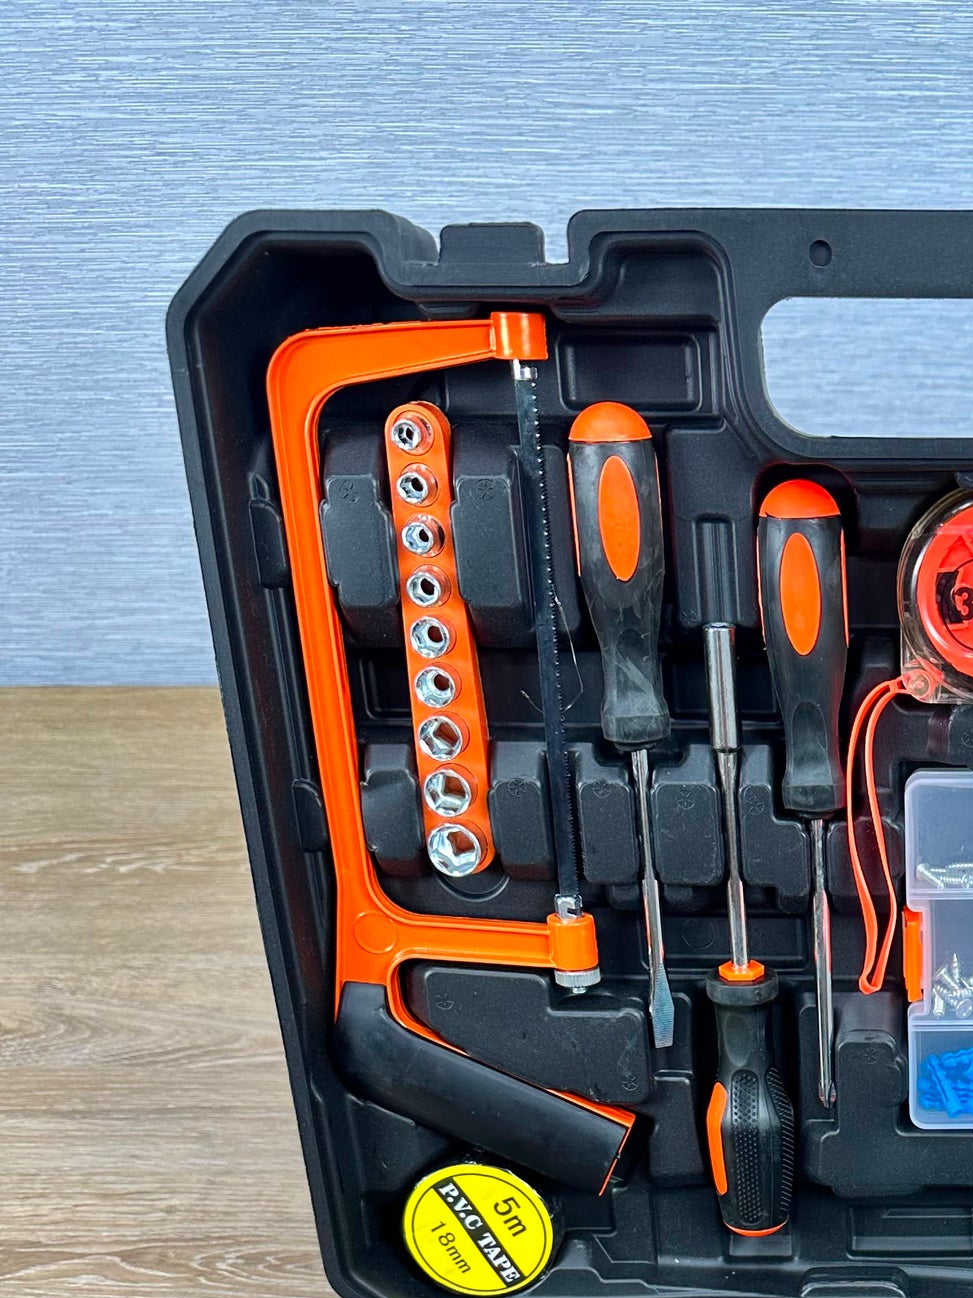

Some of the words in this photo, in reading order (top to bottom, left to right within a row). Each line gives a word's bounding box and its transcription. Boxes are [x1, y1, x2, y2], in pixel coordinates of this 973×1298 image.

[438, 1182, 484, 1230] P.V.C
[477, 1232, 521, 1283] TAPE
[493, 1196, 528, 1237] 5m
[430, 1220, 472, 1274] 18mm
